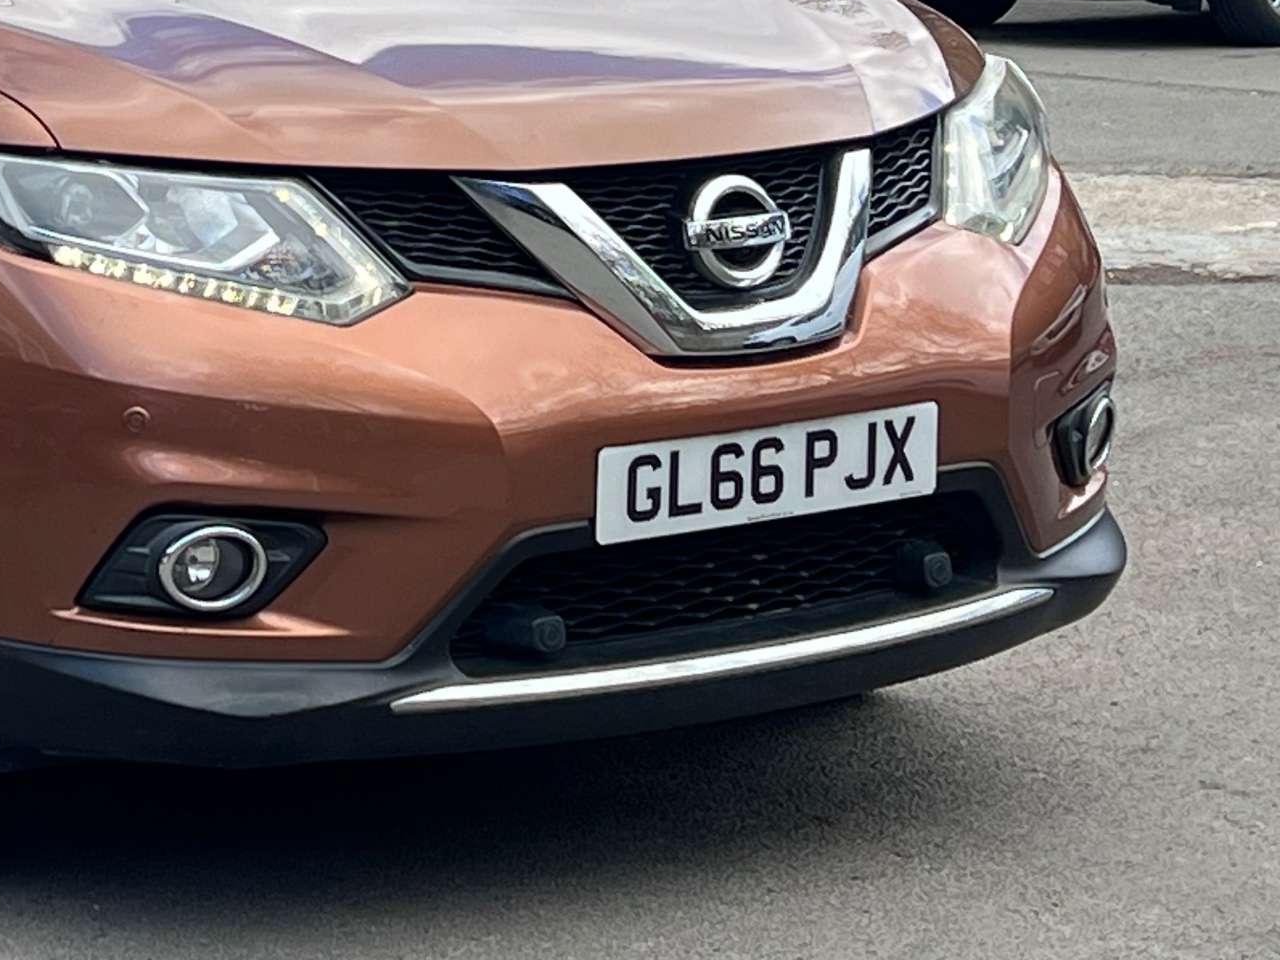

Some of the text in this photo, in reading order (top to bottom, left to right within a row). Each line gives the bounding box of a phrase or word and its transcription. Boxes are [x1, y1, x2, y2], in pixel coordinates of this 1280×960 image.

[705, 216, 786, 242] NISSAN
[627, 416, 916, 523] GL66 PJX
